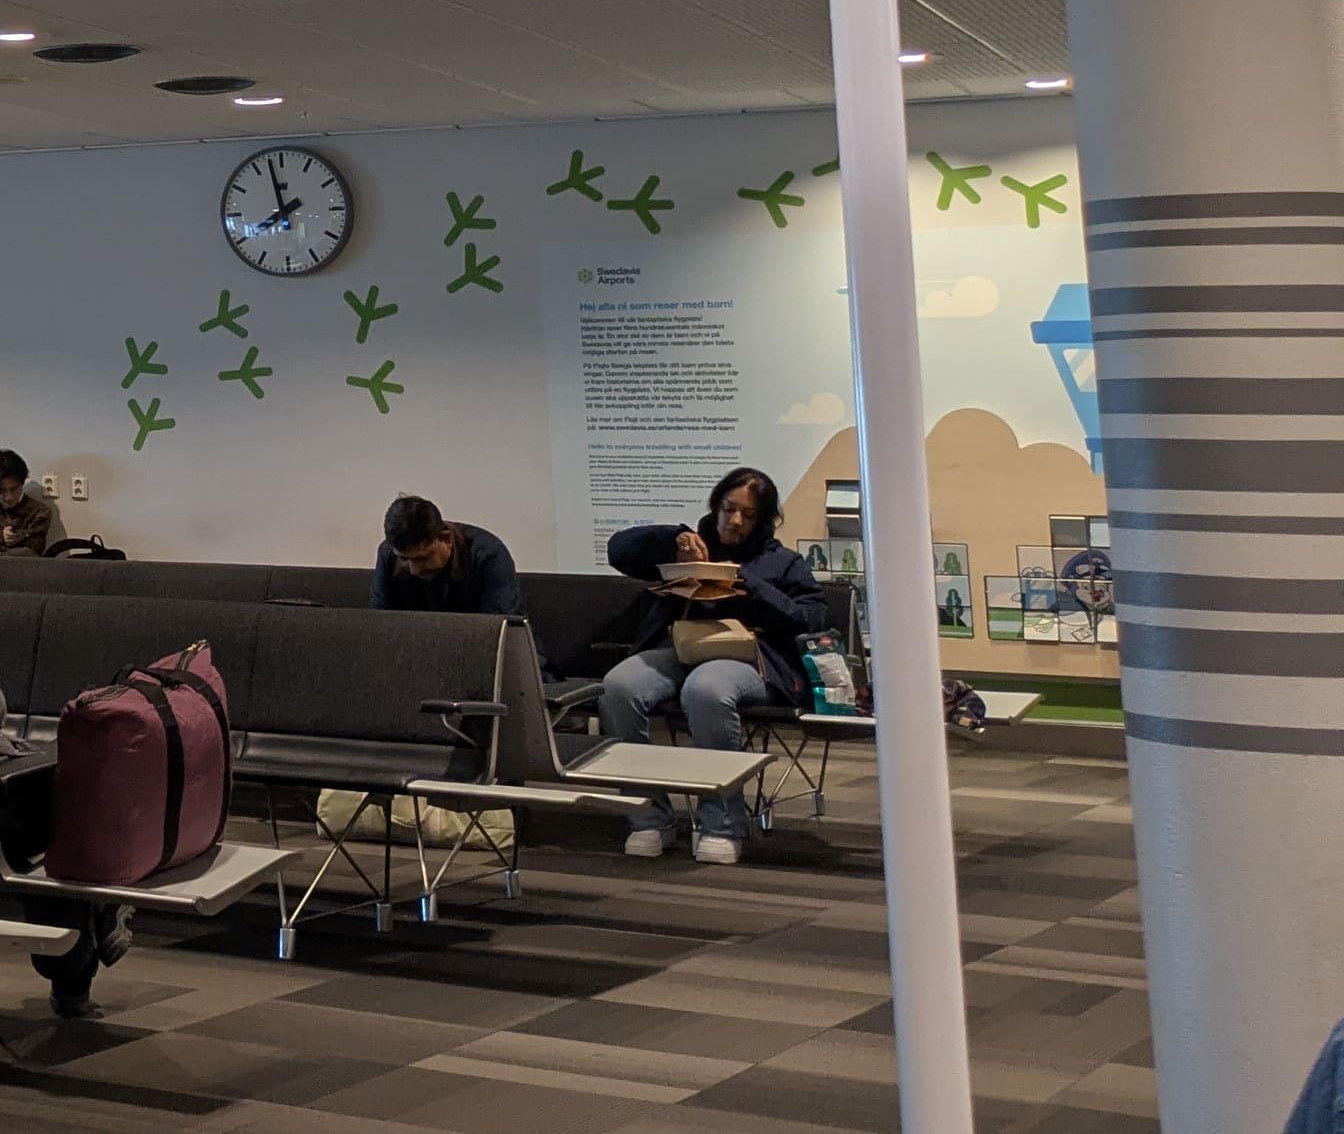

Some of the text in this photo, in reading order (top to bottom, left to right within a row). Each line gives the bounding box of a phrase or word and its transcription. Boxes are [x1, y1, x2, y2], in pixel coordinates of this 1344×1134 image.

[597, 267, 640, 276] Swedavia
[598, 276, 635, 285] Airports
[580, 303, 595, 312] Hej
[618, 302, 627, 310] ni
[682, 300, 704, 308] med
[707, 299, 734, 308] barn!
